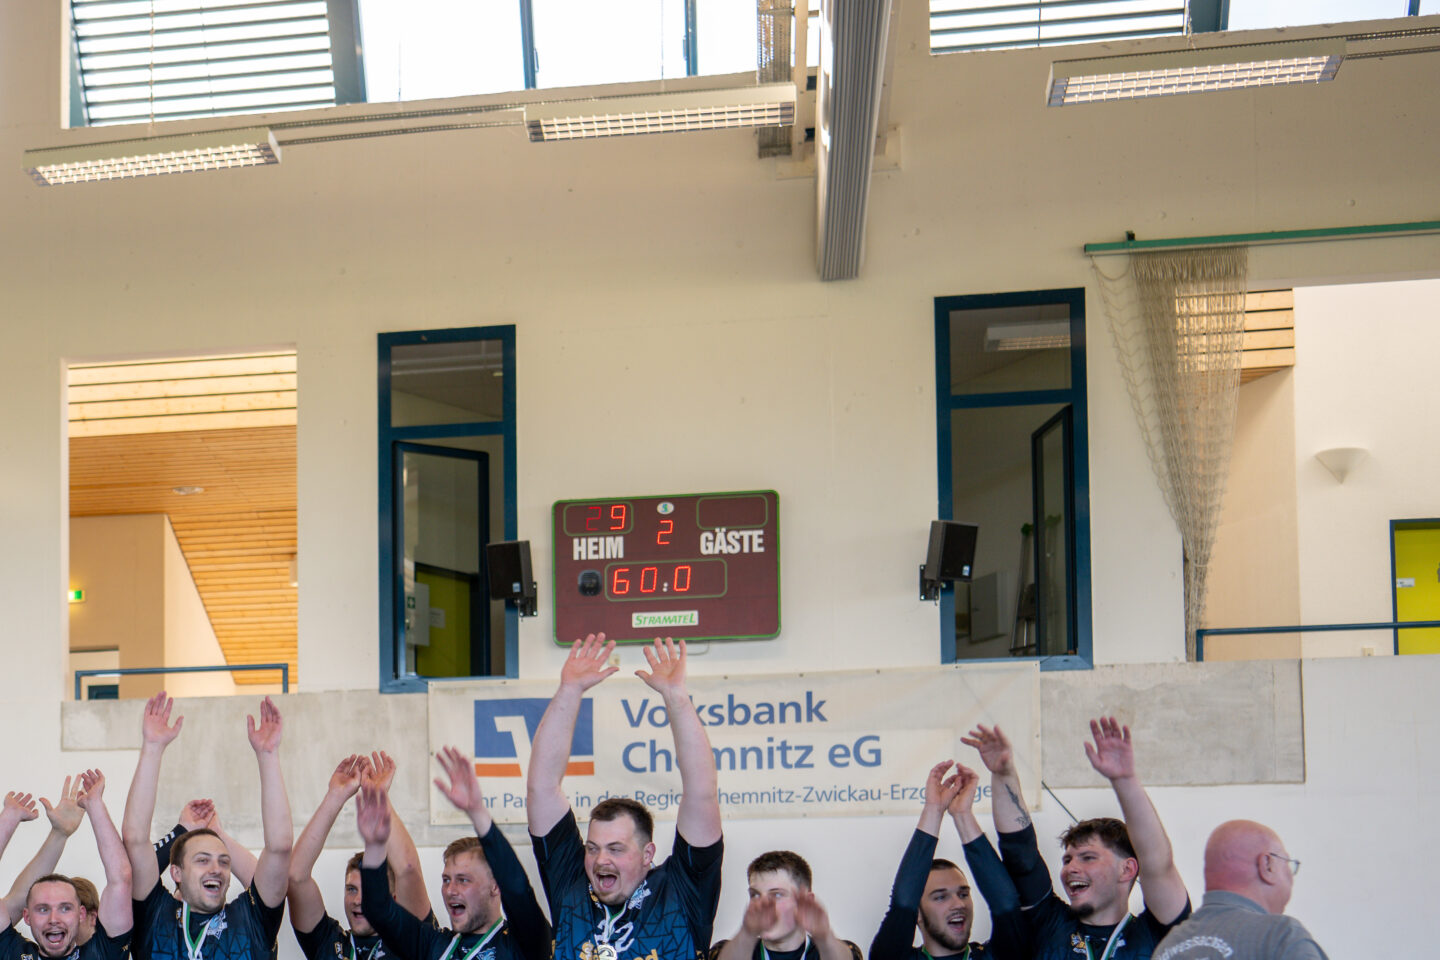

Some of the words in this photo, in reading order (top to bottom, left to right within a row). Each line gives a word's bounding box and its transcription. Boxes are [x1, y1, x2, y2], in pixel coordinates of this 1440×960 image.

[657, 519, 673, 544] 2
[699, 527, 765, 555] GÄSTE
[572, 535, 624, 560] HEIM
[634, 613, 697, 626] STRAMATEL
[620, 691, 828, 728] Voksbank
[622, 737, 814, 773] Chmnitz
[827, 735, 882, 768] eG
[575, 791, 591, 807] in
